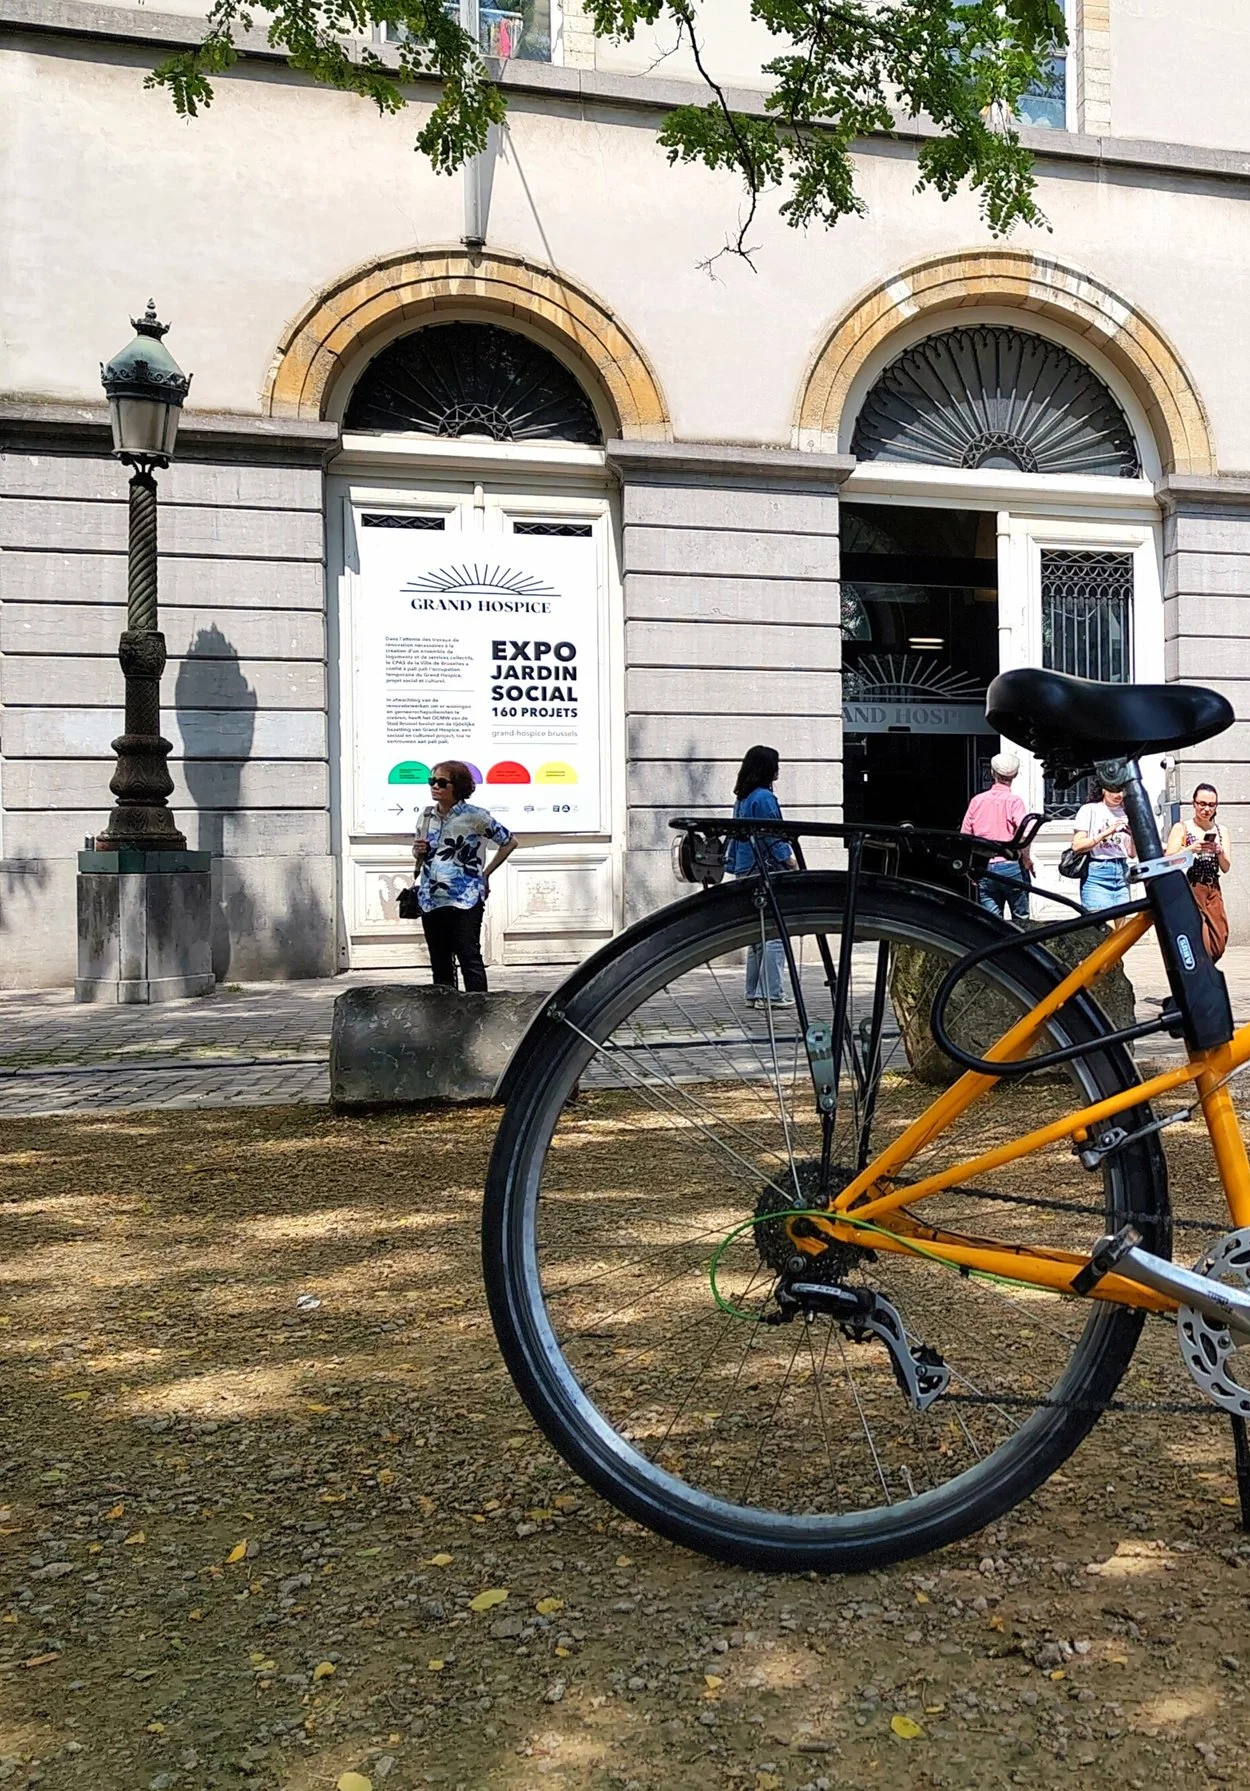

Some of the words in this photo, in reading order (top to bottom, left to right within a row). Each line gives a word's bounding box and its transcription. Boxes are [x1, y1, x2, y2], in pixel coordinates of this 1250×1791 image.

[411, 598, 472, 610] GRAND
[478, 600, 551, 613] HOSPICE
[491, 640, 576, 662] EXPO
[490, 665, 576, 681] JARDIN
[491, 685, 578, 702] SOCIAL
[492, 707, 517, 717] 160
[521, 708, 577, 718] PROJETS
